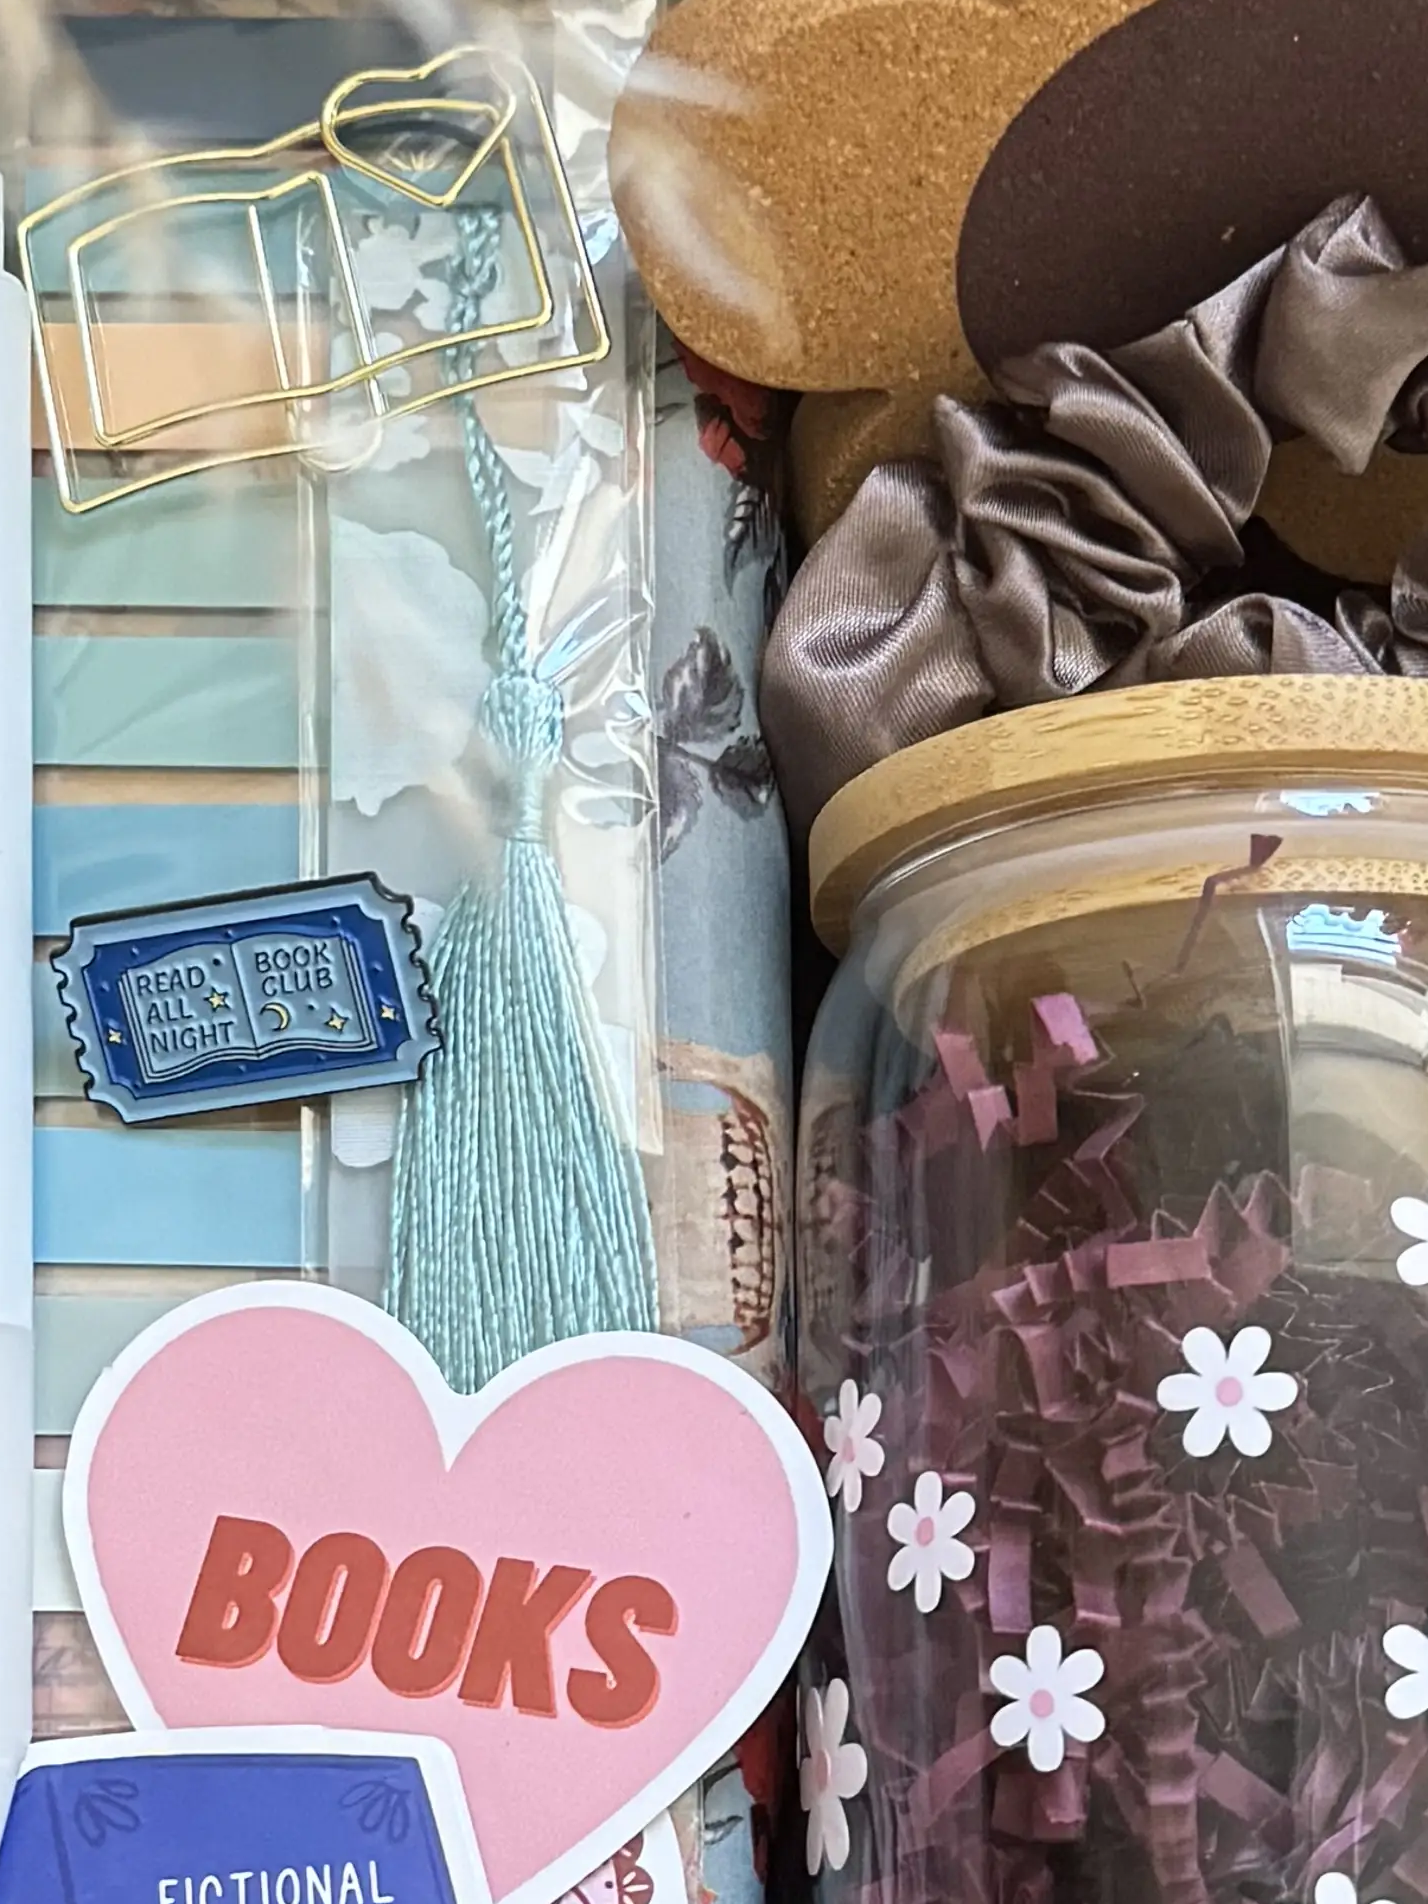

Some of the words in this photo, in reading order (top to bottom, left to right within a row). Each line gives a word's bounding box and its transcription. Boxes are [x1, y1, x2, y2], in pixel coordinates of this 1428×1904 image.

[255, 943, 332, 973] BOOK
[137, 965, 206, 997] READ
[262, 967, 333, 997] CLUB
[147, 996, 193, 1024] ALL
[150, 1021, 233, 1053] NIGHT
[175, 1516, 678, 1729] BOOKS
